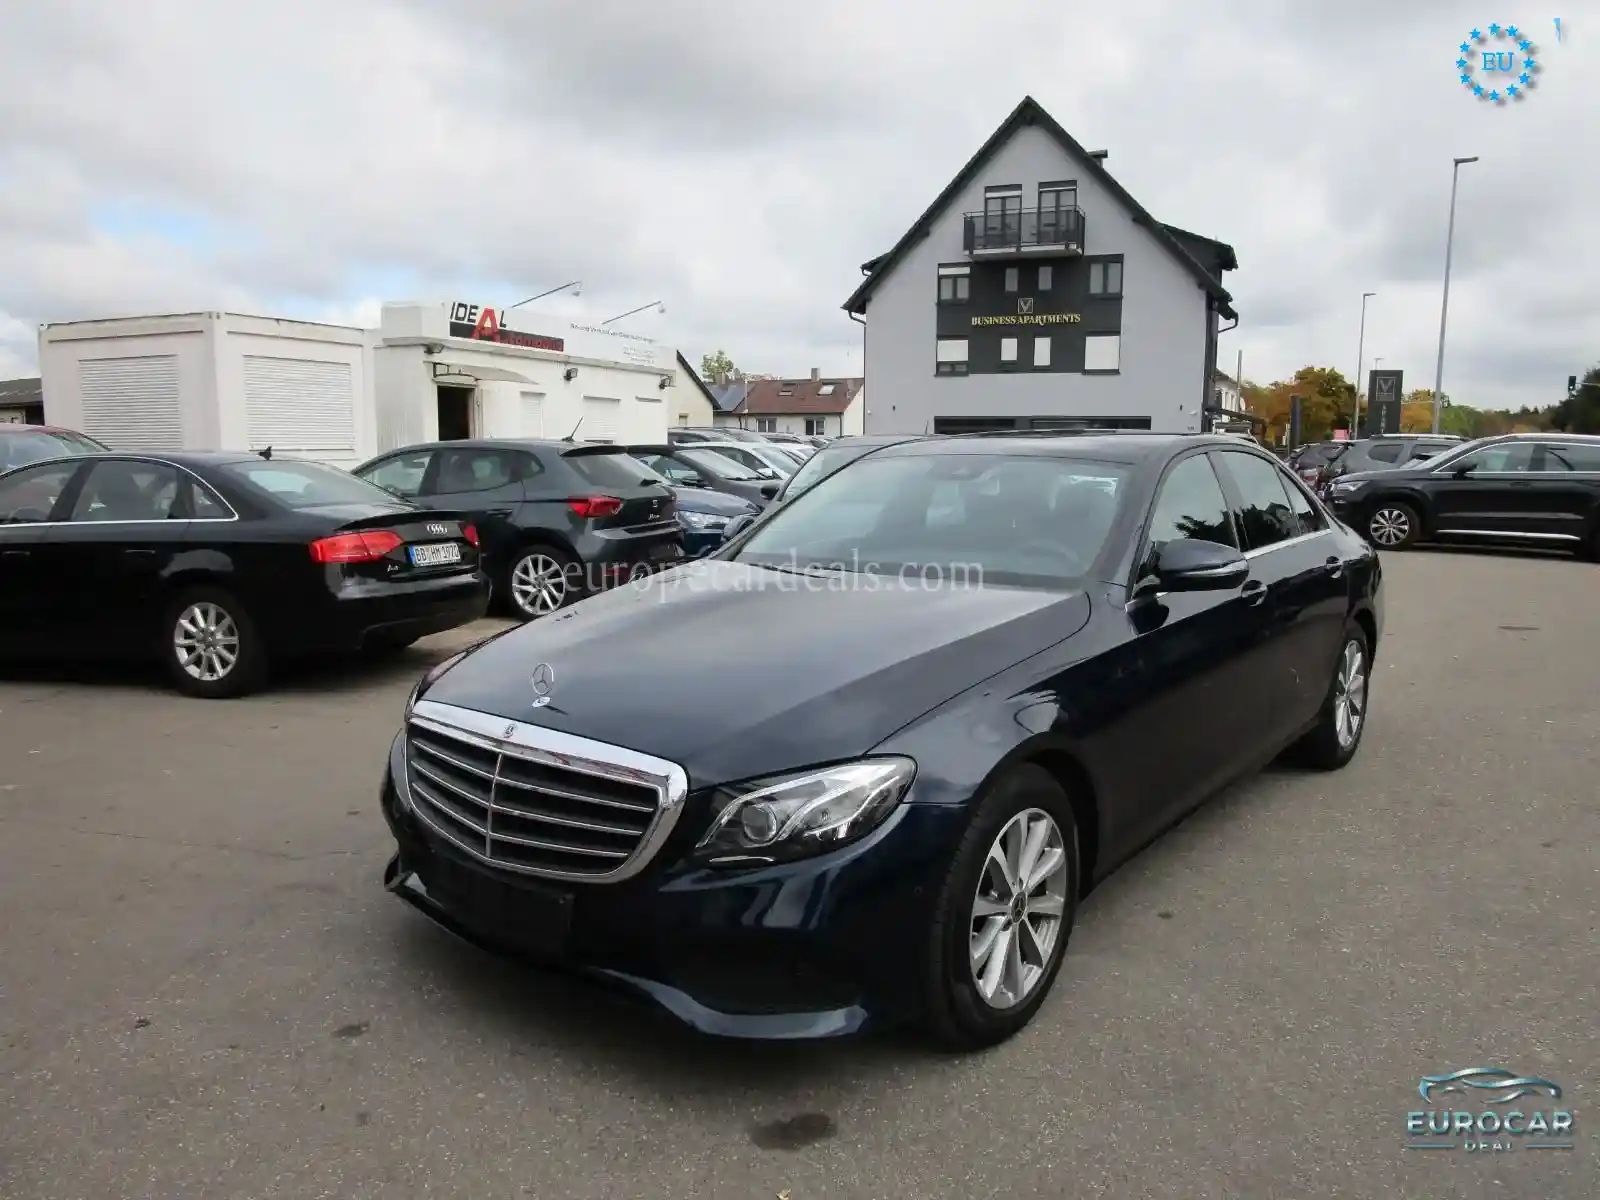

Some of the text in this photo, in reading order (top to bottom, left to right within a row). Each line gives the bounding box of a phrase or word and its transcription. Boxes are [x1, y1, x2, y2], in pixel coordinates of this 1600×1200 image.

[450, 302, 507, 339] IDEAL
[971, 313, 1081, 326] BUSINESS APARTMENTS
